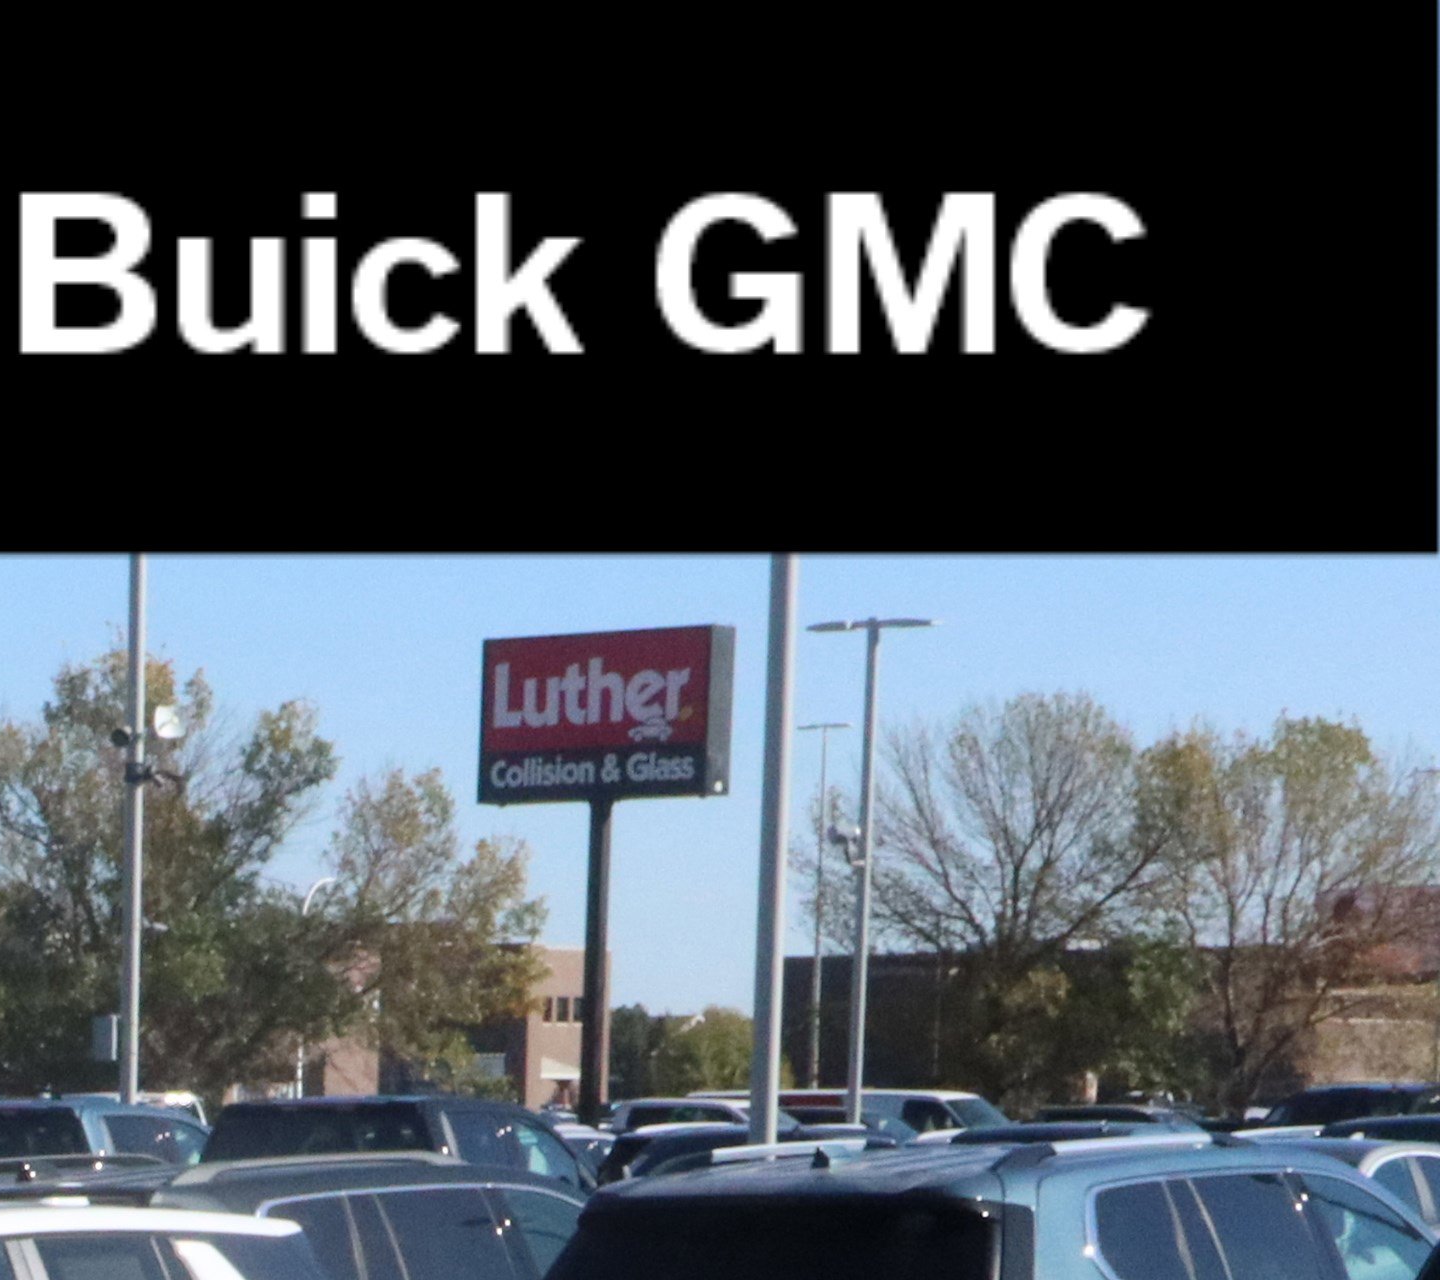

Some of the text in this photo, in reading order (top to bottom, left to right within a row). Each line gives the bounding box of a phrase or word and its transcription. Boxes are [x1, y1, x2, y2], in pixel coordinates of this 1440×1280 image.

[493, 657, 692, 729] Luther
[490, 752, 696, 789] Collision & Glass
